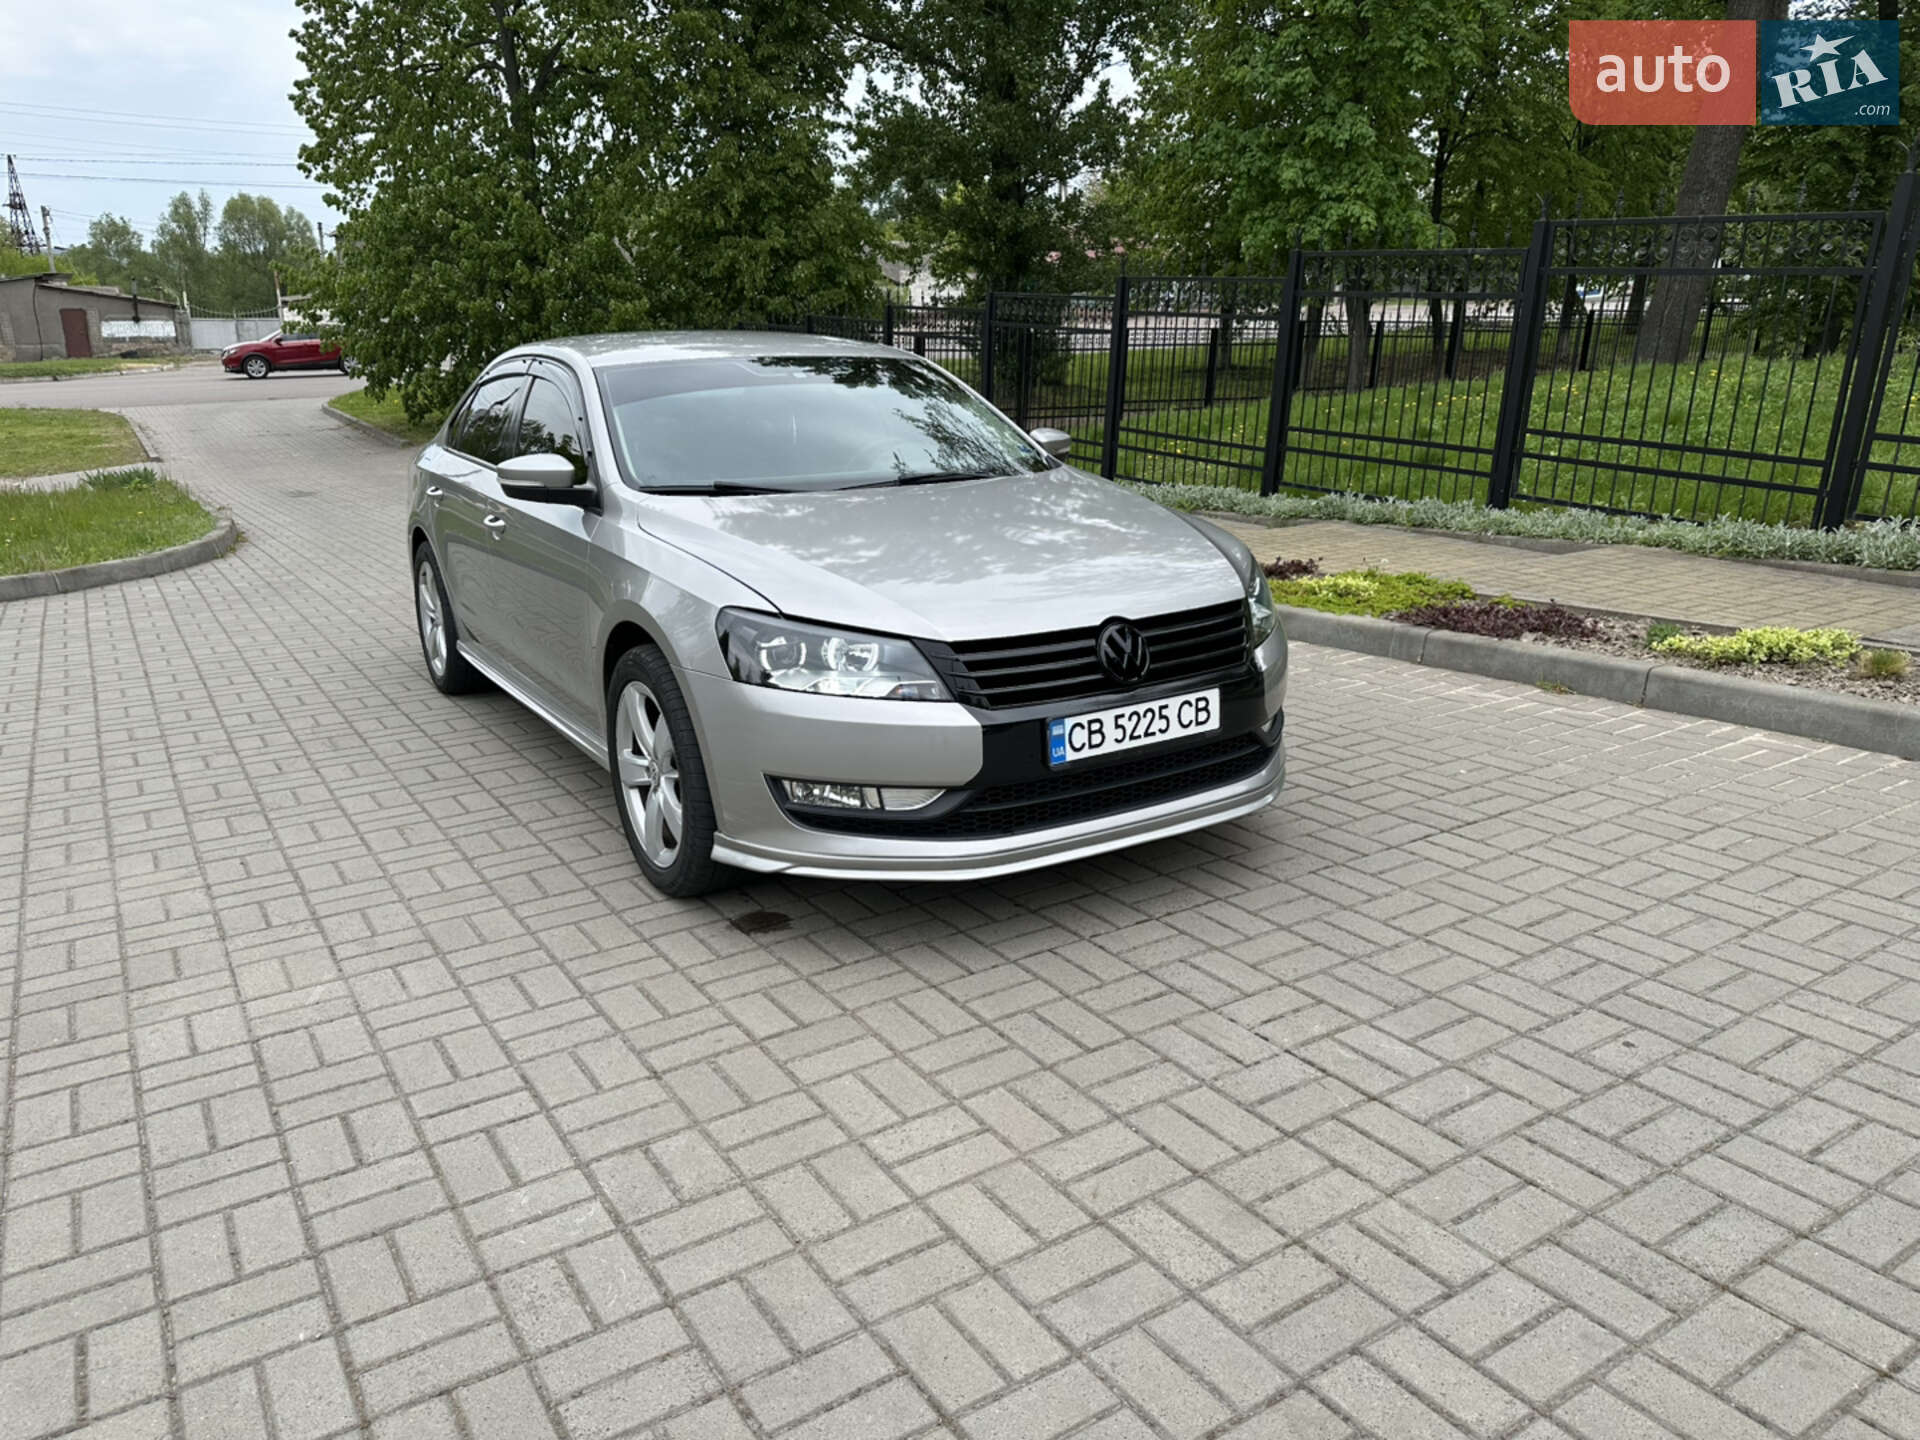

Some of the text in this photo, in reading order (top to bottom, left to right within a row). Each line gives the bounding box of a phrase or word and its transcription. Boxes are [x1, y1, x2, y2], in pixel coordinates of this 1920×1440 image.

[1068, 696, 1212, 753] CB 5225 CB
